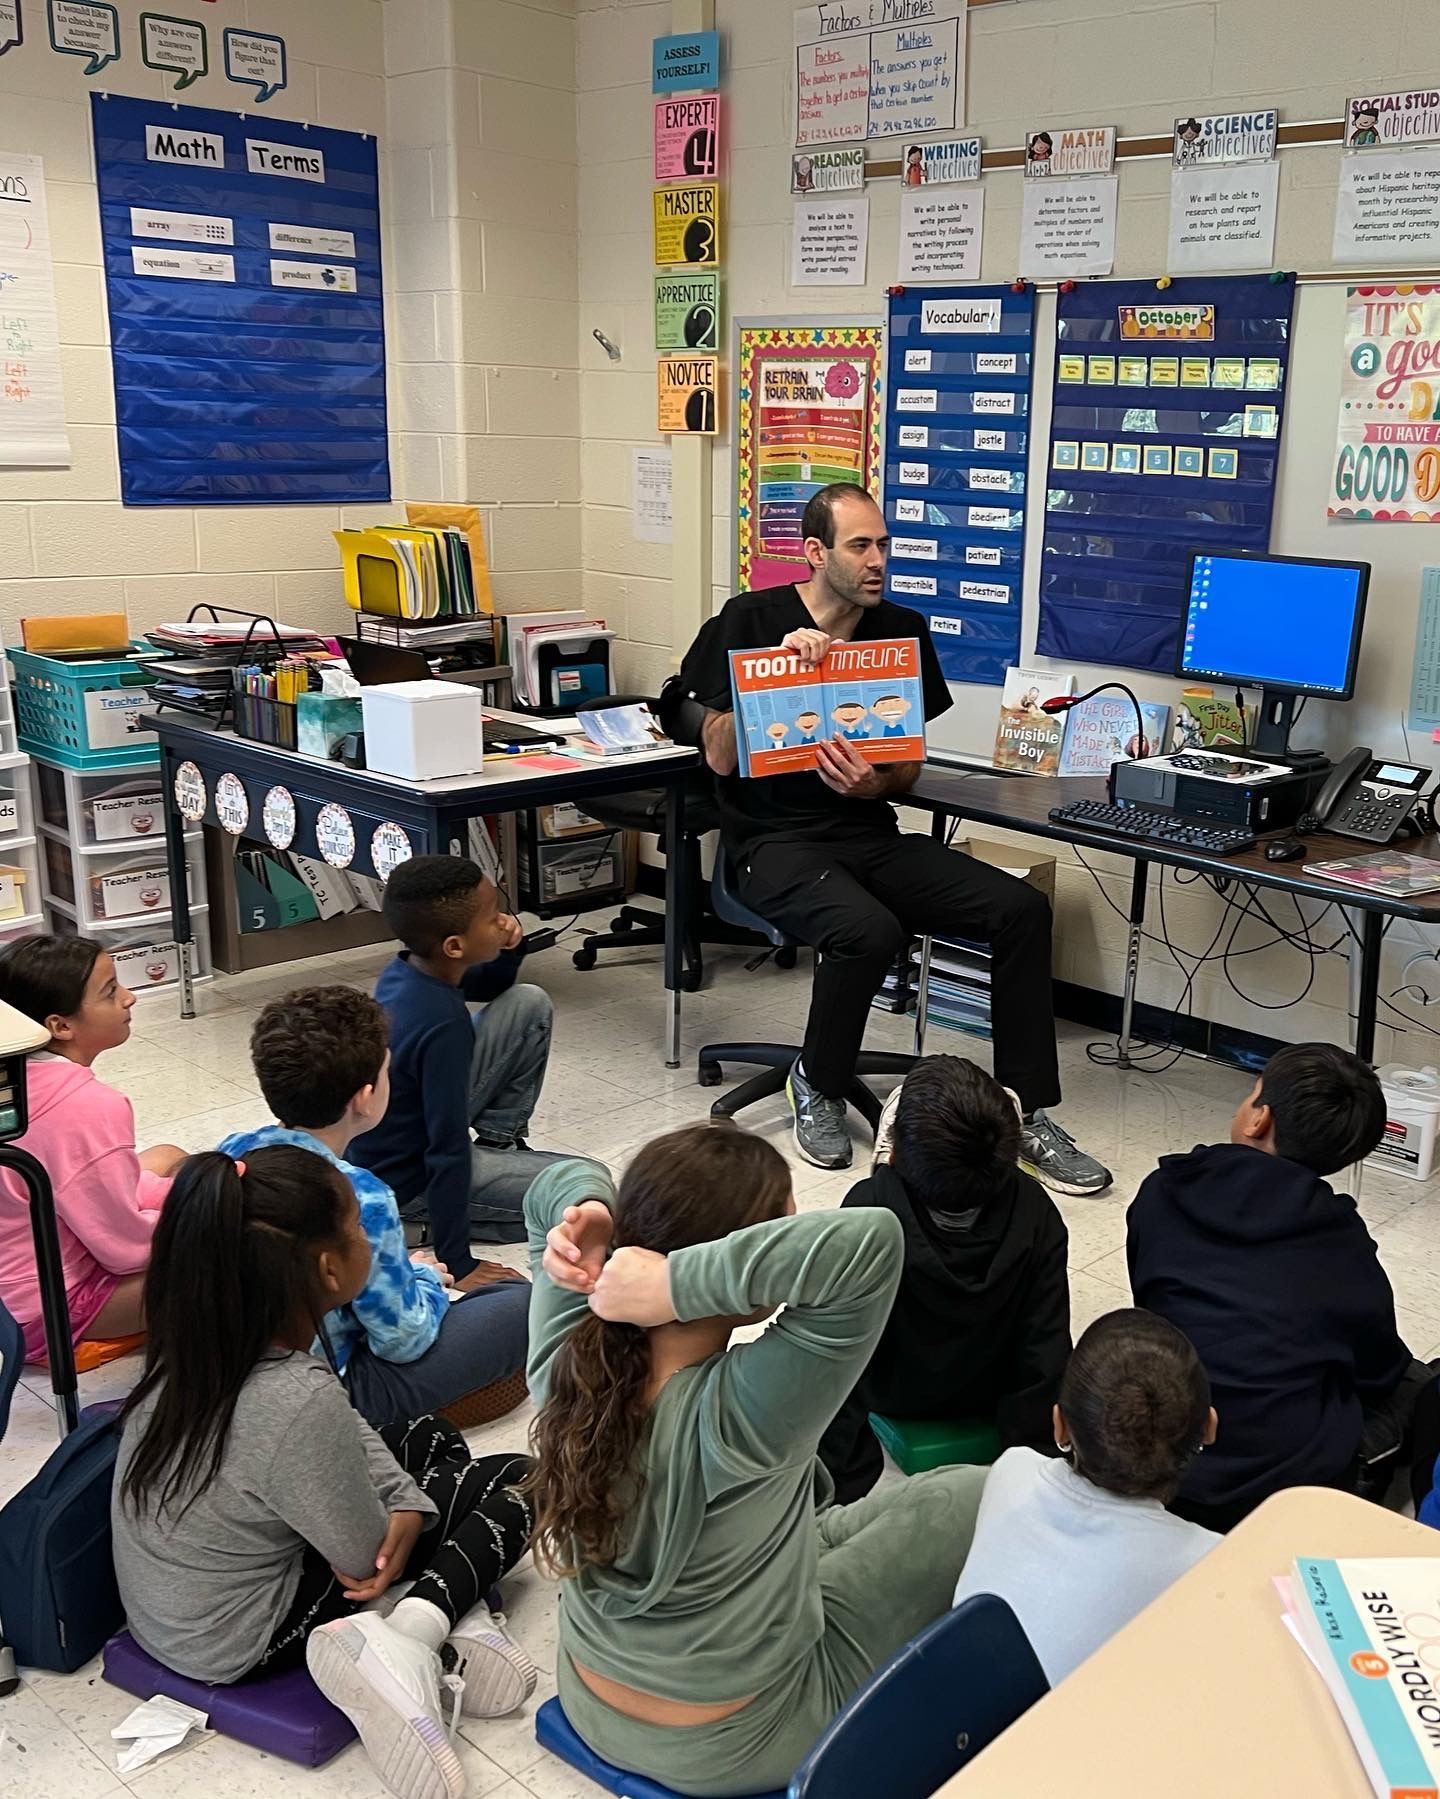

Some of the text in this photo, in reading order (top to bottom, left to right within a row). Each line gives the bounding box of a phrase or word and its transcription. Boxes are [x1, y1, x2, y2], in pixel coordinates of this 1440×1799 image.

[818, 0, 934, 34] Factors Multiples
[897, 33, 932, 48] Multiples
[664, 46, 701, 61] ASSESS
[816, 48, 842, 64] Factors
[657, 63, 710, 79] YOURSELF!
[1352, 92, 1440, 115] SOCIAL STUD
[665, 101, 715, 128] EXPERT!
[1204, 113, 1274, 136] SCIENCE
[1061, 130, 1105, 149] MATH
[1208, 131, 1272, 160] objectives
[155, 133, 320, 174] Math Terms
[693, 129, 713, 174] 4
[924, 141, 978, 161] WRITING
[814, 151, 863, 169] READING
[1054, 149, 1109, 176] objectives
[927, 158, 978, 183] objectives
[1353, 174, 1365, 182] We
[1383, 172, 1391, 180] be
[1395, 171, 1409, 179] able
[814, 167, 861, 192] objectives
[1356, 186, 1375, 194] about
[1379, 184, 1409, 194] Hispanic
[664, 190, 712, 216] MASTER
[1189, 191, 1259, 203] We will be able to
[1358, 195, 1438, 207] month by researching
[1185, 204, 1261, 217] research and report
[1362, 208, 1432, 218] influential Hispanic
[147, 221, 170, 231] array
[1189, 217, 1255, 230] on how plants and
[1353, 220, 1439, 230] Americans and creating
[697, 218, 714, 262] 3
[1180, 230, 1262, 243] animals are classified.
[1355, 232, 1431, 242] informative projects.
[142, 258, 180, 269] equation
[657, 284, 713, 303] APPRENTICE
[1139, 310, 1198, 325] October
[1362, 302, 1423, 337] IT'S
[693, 306, 715, 349] 2
[908, 357, 927, 365] alert
[979, 358, 1013, 369] concept
[1357, 348, 1375, 370] a
[667, 362, 712, 386] NOVICE
[765, 371, 808, 385] RETRAIN
[765, 386, 823, 401] YOUR BRAIN
[900, 395, 934, 404] accustom
[975, 397, 1011, 407] distract
[701, 390, 707, 431] 1
[902, 431, 925, 442] assign
[1376, 425, 1430, 441] TO HAVE
[977, 435, 1002, 447] jostle
[1062, 451, 1227, 468] 2 3 5 6 7
[903, 470, 925, 480] budge
[972, 473, 1007, 485] obstacle
[1335, 445, 1409, 502] GOOD
[900, 507, 919, 517] burly
[895, 543, 933, 553] companion
[968, 551, 997, 560] patient
[893, 580, 933, 590] compatible
[962, 585, 1007, 598] pedestrian
[933, 619, 958, 631] retire
[828, 646, 911, 671] TIMELINE
[100, 696, 144, 707] Teacher
[1081, 702, 1098, 715] THE
[1217, 703, 1230, 712] Day
[1008, 717, 1020, 725] The
[1072, 718, 1097, 732] WHO
[1000, 724, 1059, 744] Invisible
[1072, 735, 1102, 751] MADE
[1018, 742, 1045, 762] Boy
[94, 801, 136, 812] Teacher
[182, 794, 200, 812] DAY
[223, 807, 243, 824] THIS
[383, 832, 402, 848] MAKE
[389, 847, 397, 862] IT
[105, 875, 144, 887] Teacher
[304, 865, 328, 906] TC Test
[252, 907, 266, 929] 5
[288, 903, 299, 918] 5
[112, 950, 150, 961] Teacher
[1361, 1590, 1407, 1643] WISE
[1387, 1646, 1440, 1747] WORDLY
